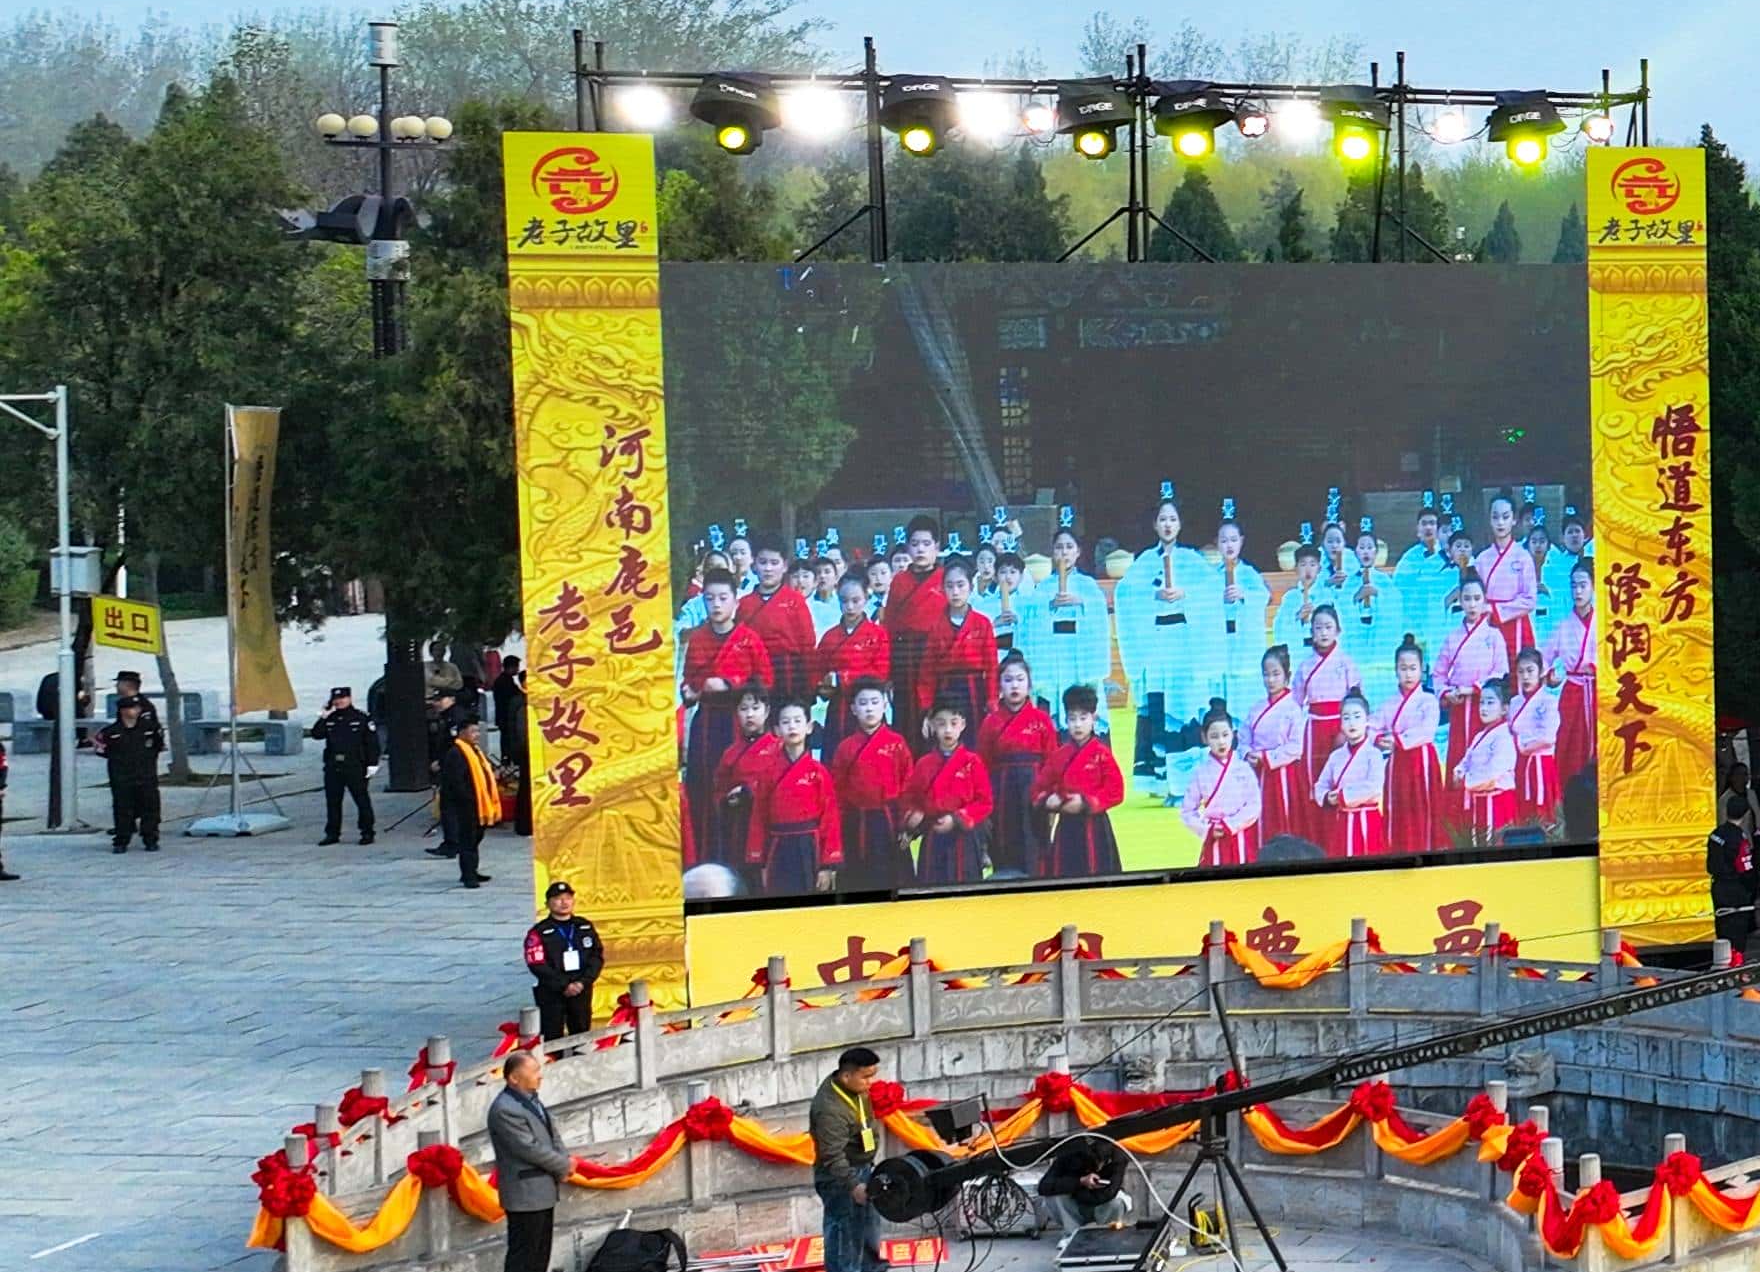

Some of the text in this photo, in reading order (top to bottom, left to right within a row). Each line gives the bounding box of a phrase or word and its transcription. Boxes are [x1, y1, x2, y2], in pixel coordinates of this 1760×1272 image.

[518, 217, 639, 249] 老子故里
[1598, 217, 1695, 245] 老子故里
[105, 606, 149, 634] 出口
[601, 425, 662, 655] 河南鹿邑
[1651, 404, 1703, 624] 悟道东方
[537, 582, 600, 807] 老子故里
[1604, 562, 1658, 775] 泽润天下
